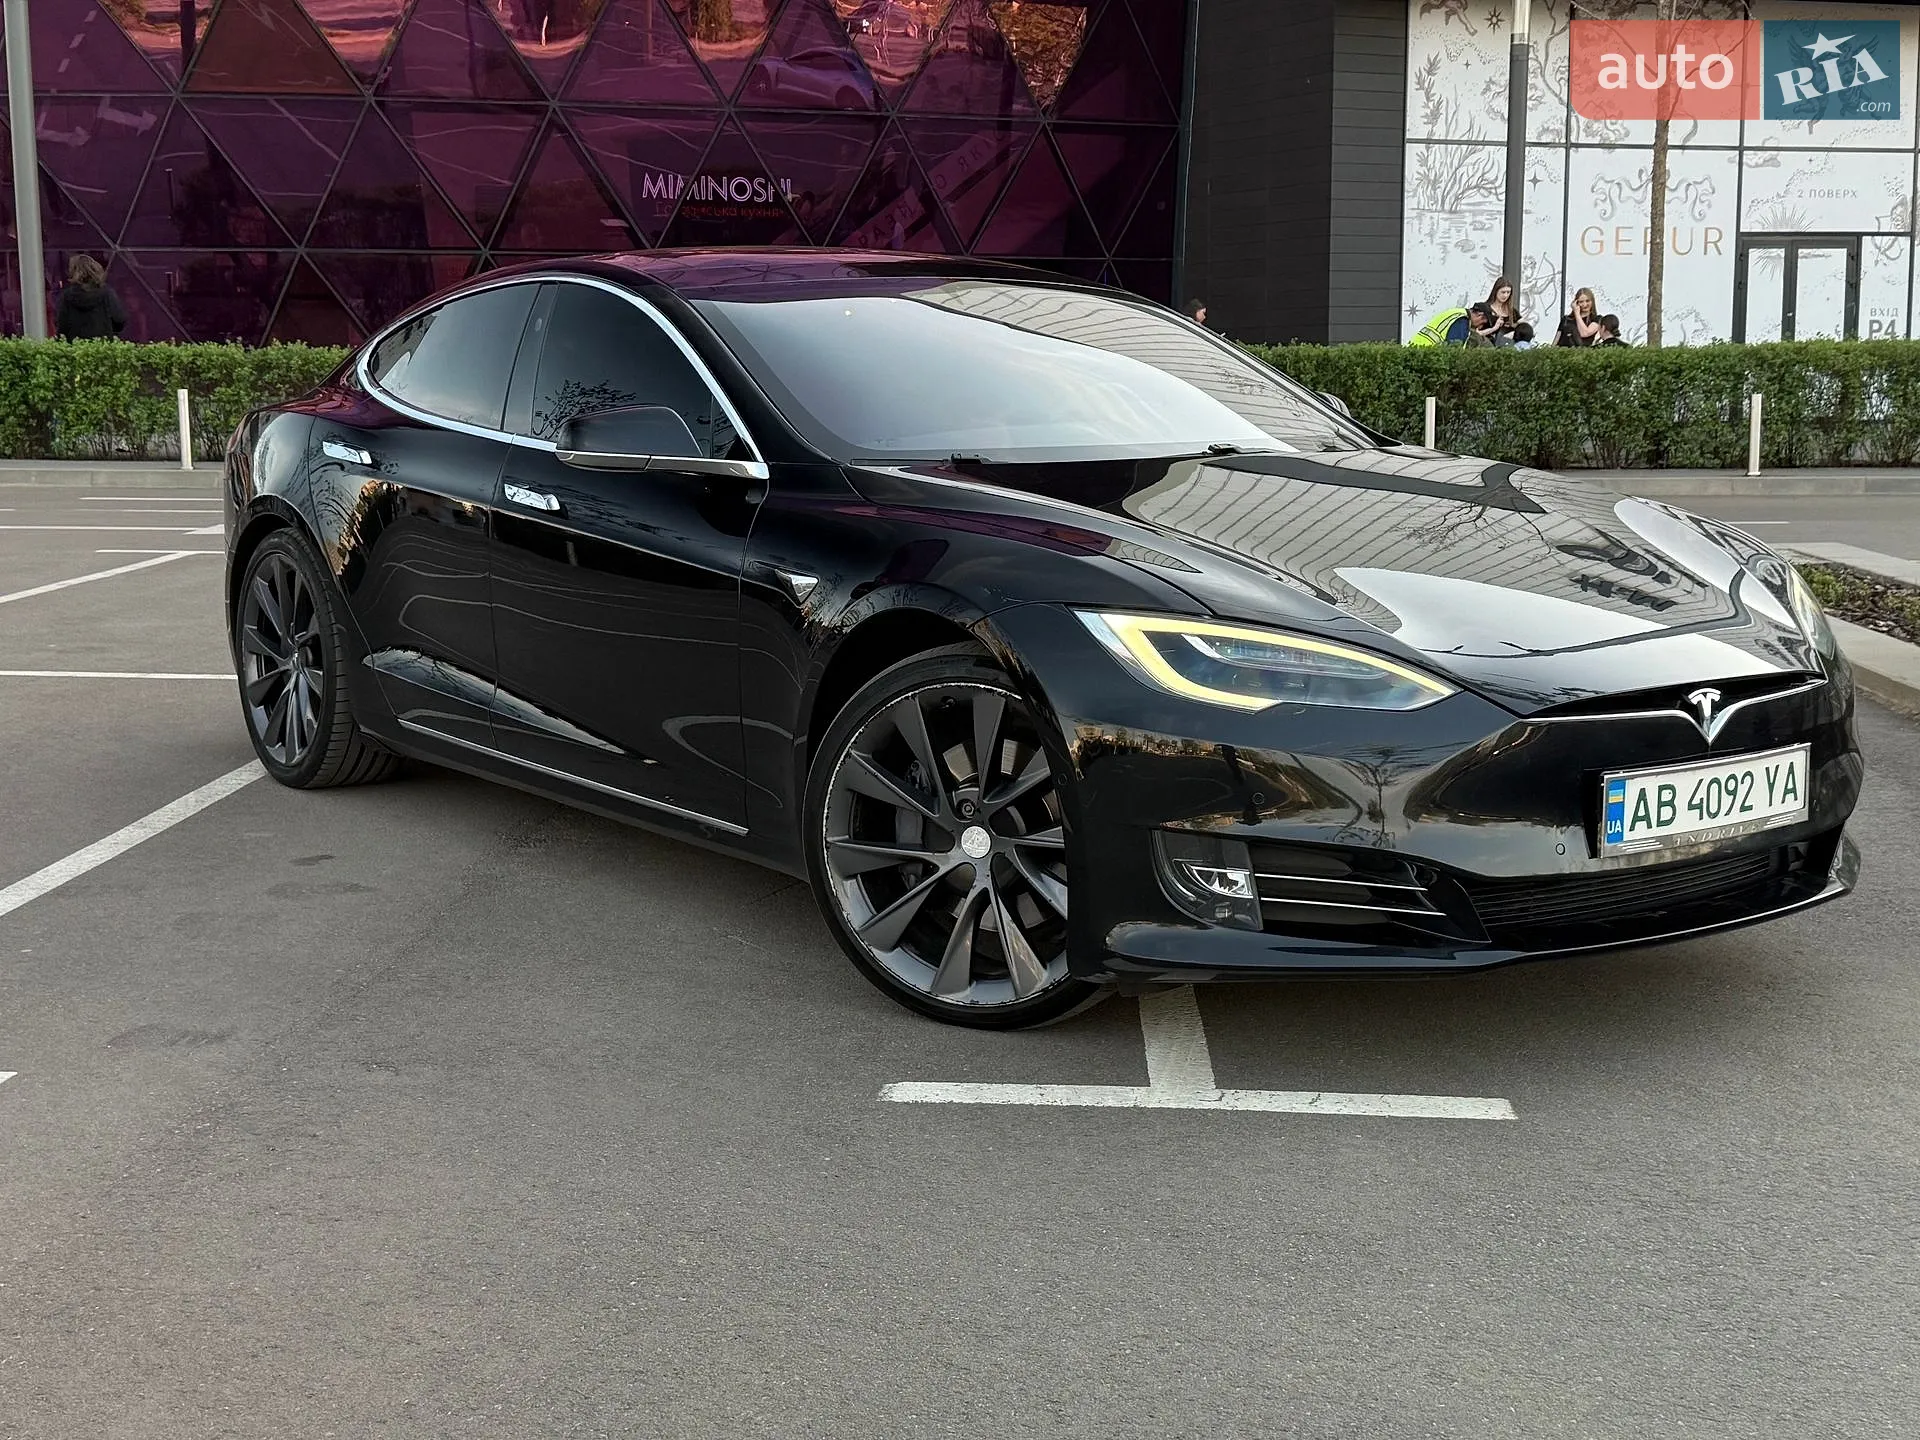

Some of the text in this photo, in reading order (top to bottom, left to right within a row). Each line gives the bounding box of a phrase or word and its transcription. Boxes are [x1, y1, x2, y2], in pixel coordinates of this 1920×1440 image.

[642, 172, 793, 203] MIMINOSHI
[1797, 188, 1858, 199] 2 ПОВЕРХ
[1870, 307, 1899, 318] ВХІД
[1628, 761, 1799, 832] AB 4092 YA
[1607, 820, 1623, 834] UA
